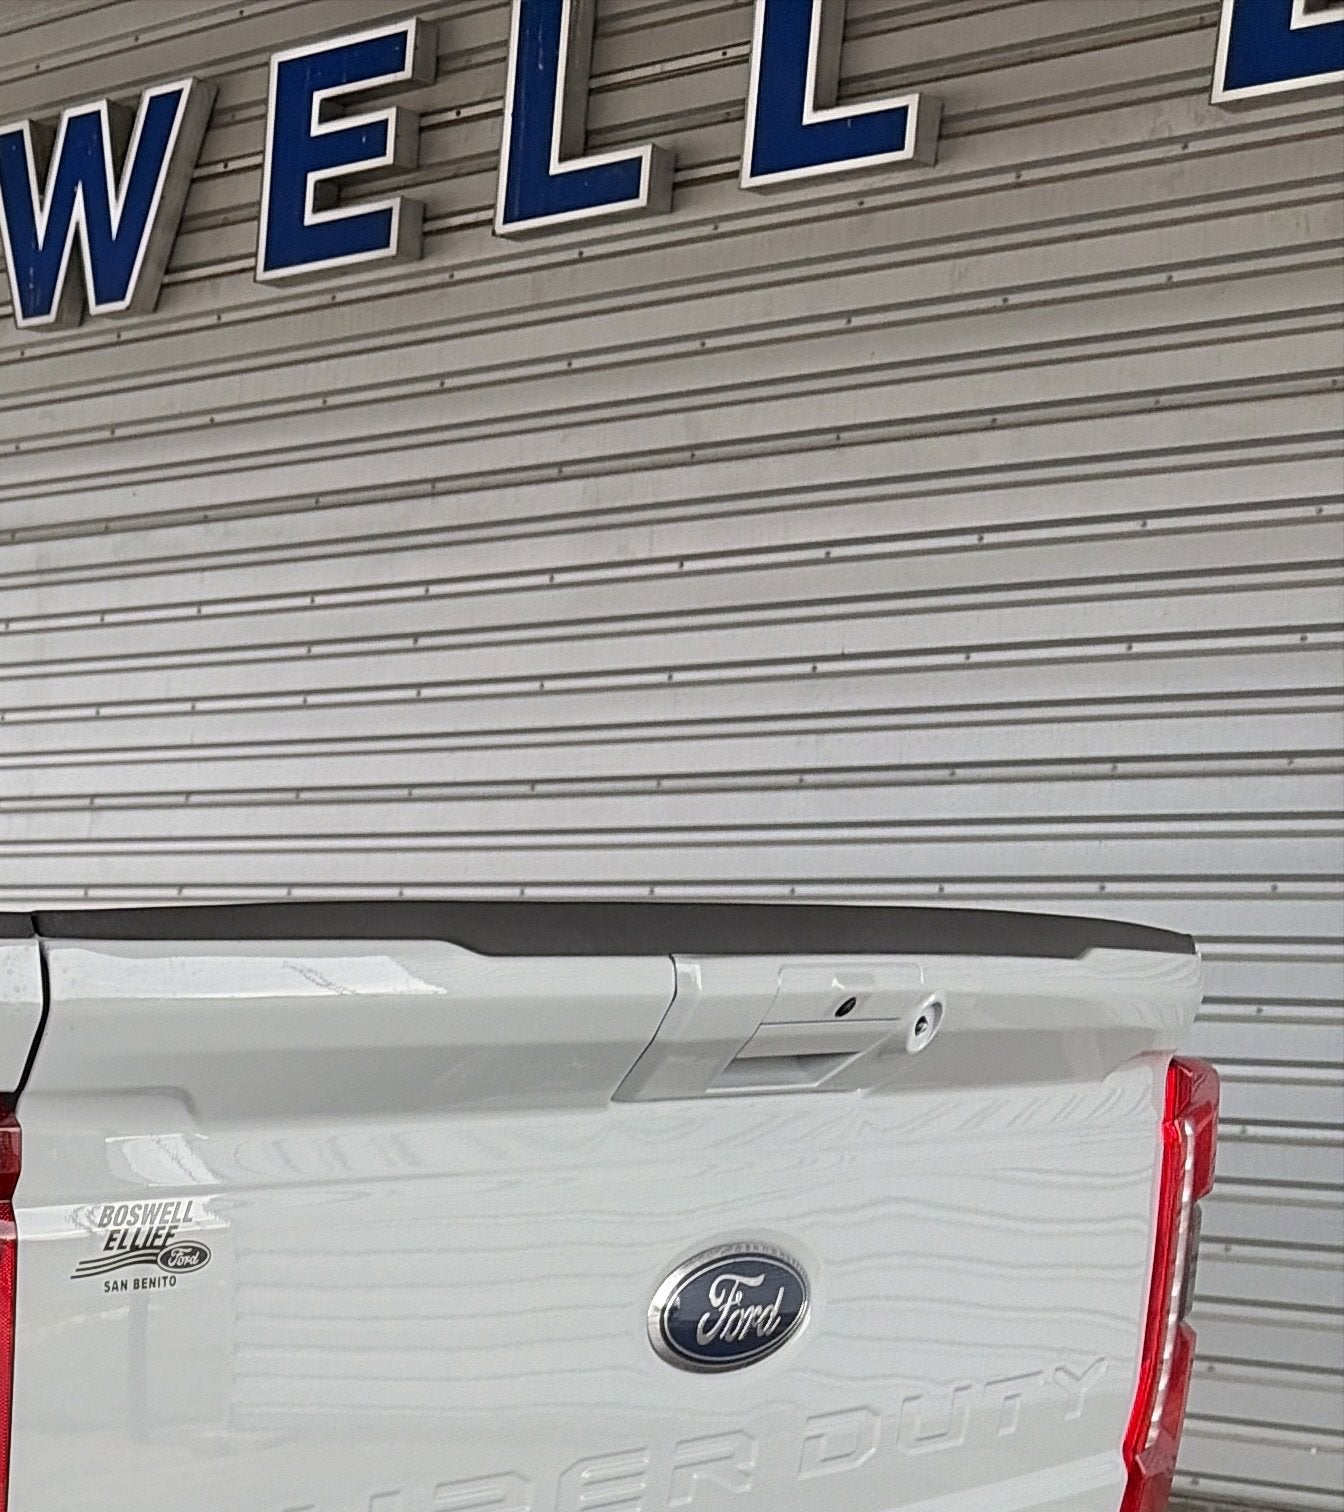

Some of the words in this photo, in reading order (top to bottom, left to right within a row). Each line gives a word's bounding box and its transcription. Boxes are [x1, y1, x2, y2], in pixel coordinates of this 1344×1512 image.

[98, 1199, 194, 1229] BOSWELL
[103, 1279, 129, 1293] SAN
[133, 1275, 177, 1291] BENITO
[695, 1273, 785, 1346] Ford
[797, 1356, 1109, 1482] DUTY
